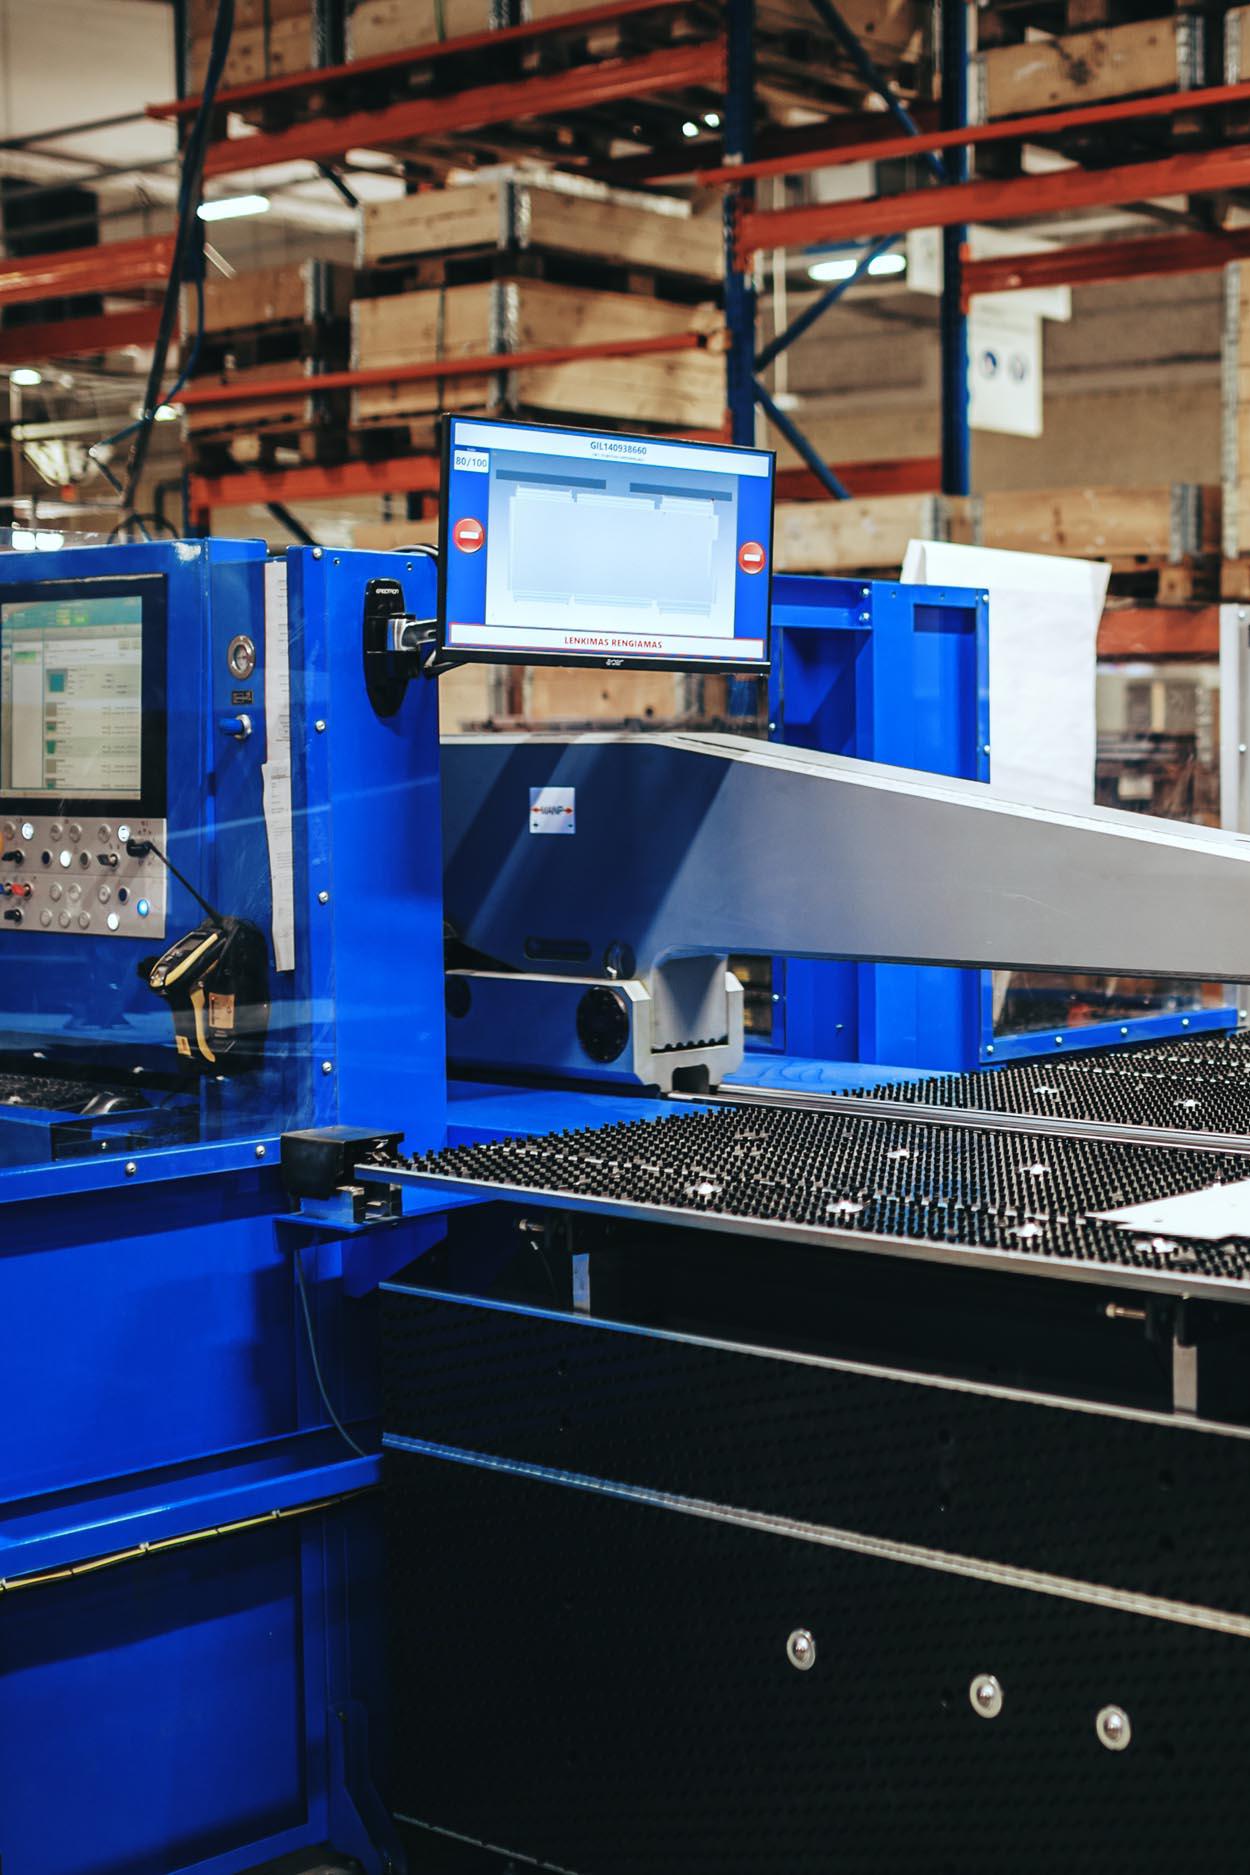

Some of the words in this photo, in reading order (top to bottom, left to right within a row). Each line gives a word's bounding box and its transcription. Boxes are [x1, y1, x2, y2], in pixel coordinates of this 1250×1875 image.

[455, 456, 487, 468] 80/100
[564, 636, 609, 646] LENKIMAS
[611, 639, 663, 649] RENGIAMAS
